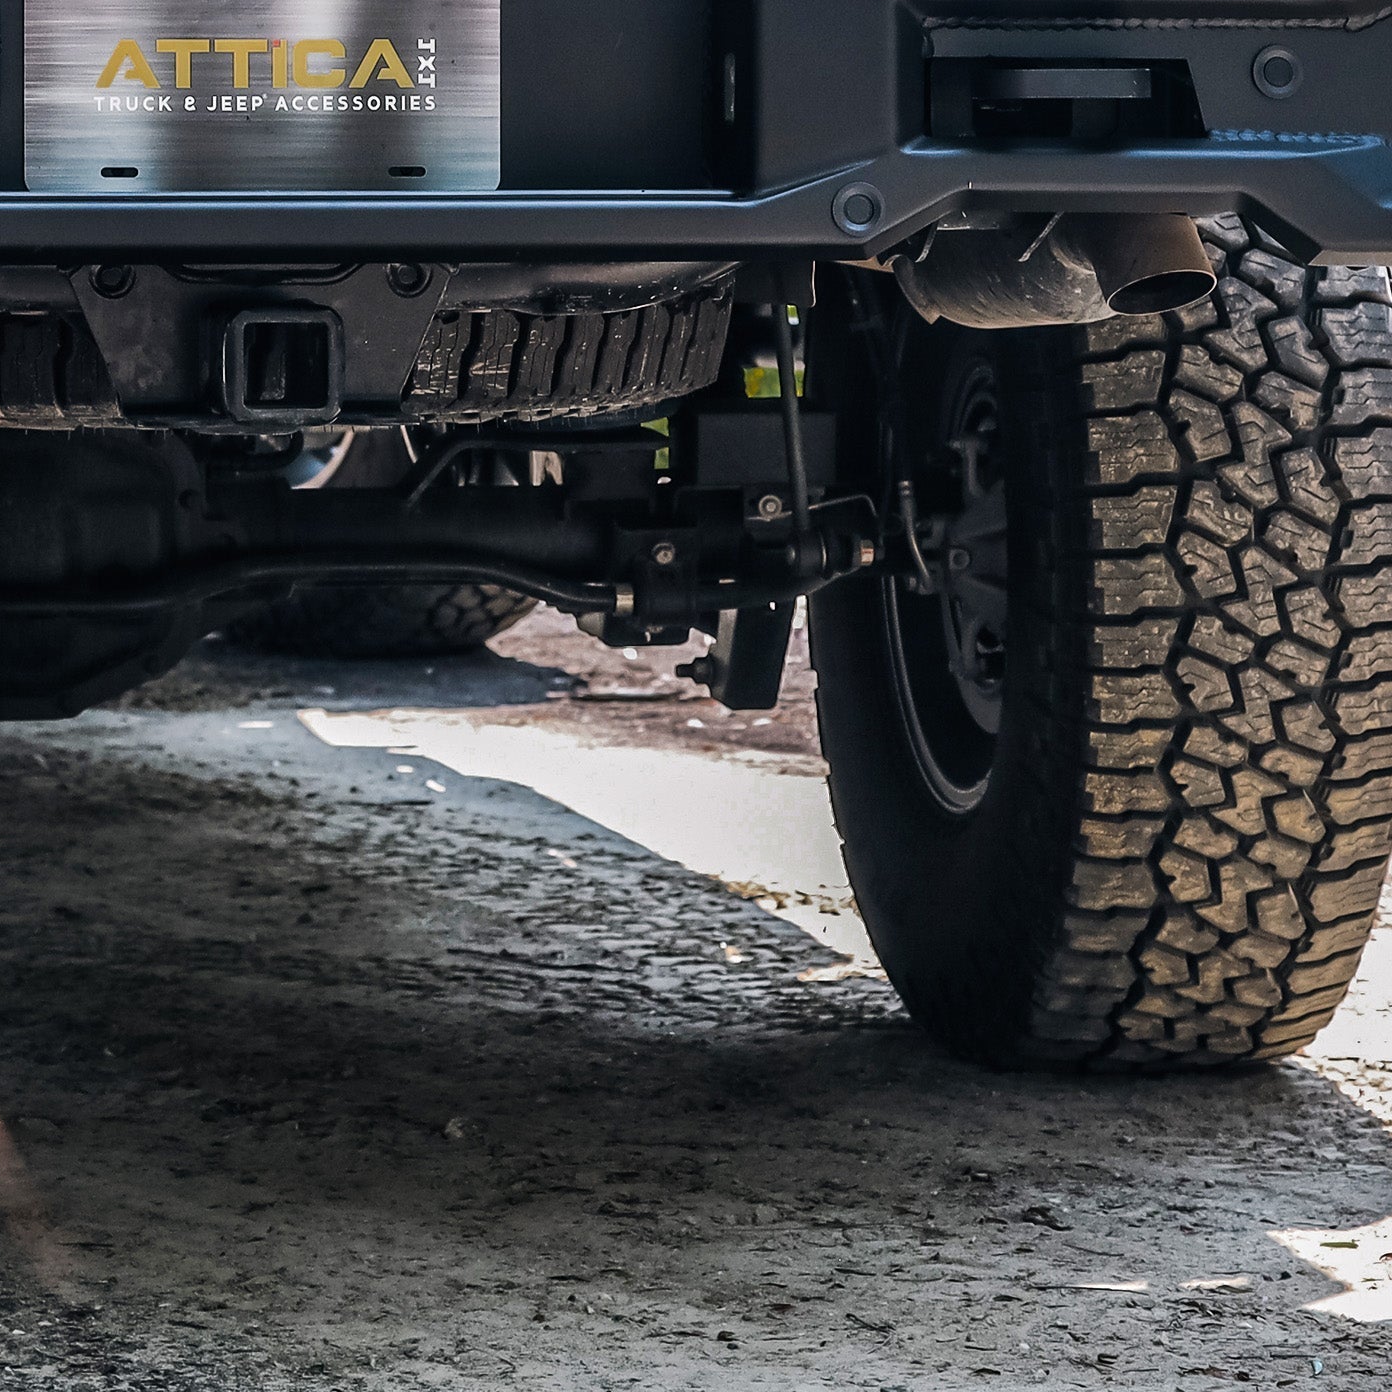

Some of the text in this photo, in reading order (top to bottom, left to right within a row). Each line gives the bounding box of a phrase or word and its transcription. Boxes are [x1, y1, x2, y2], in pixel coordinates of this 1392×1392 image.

[95, 38, 416, 89] ATTICA
[93, 95, 173, 112] TRUCK
[183, 95, 197, 112] &
[274, 95, 437, 112] ACCESSORIES
